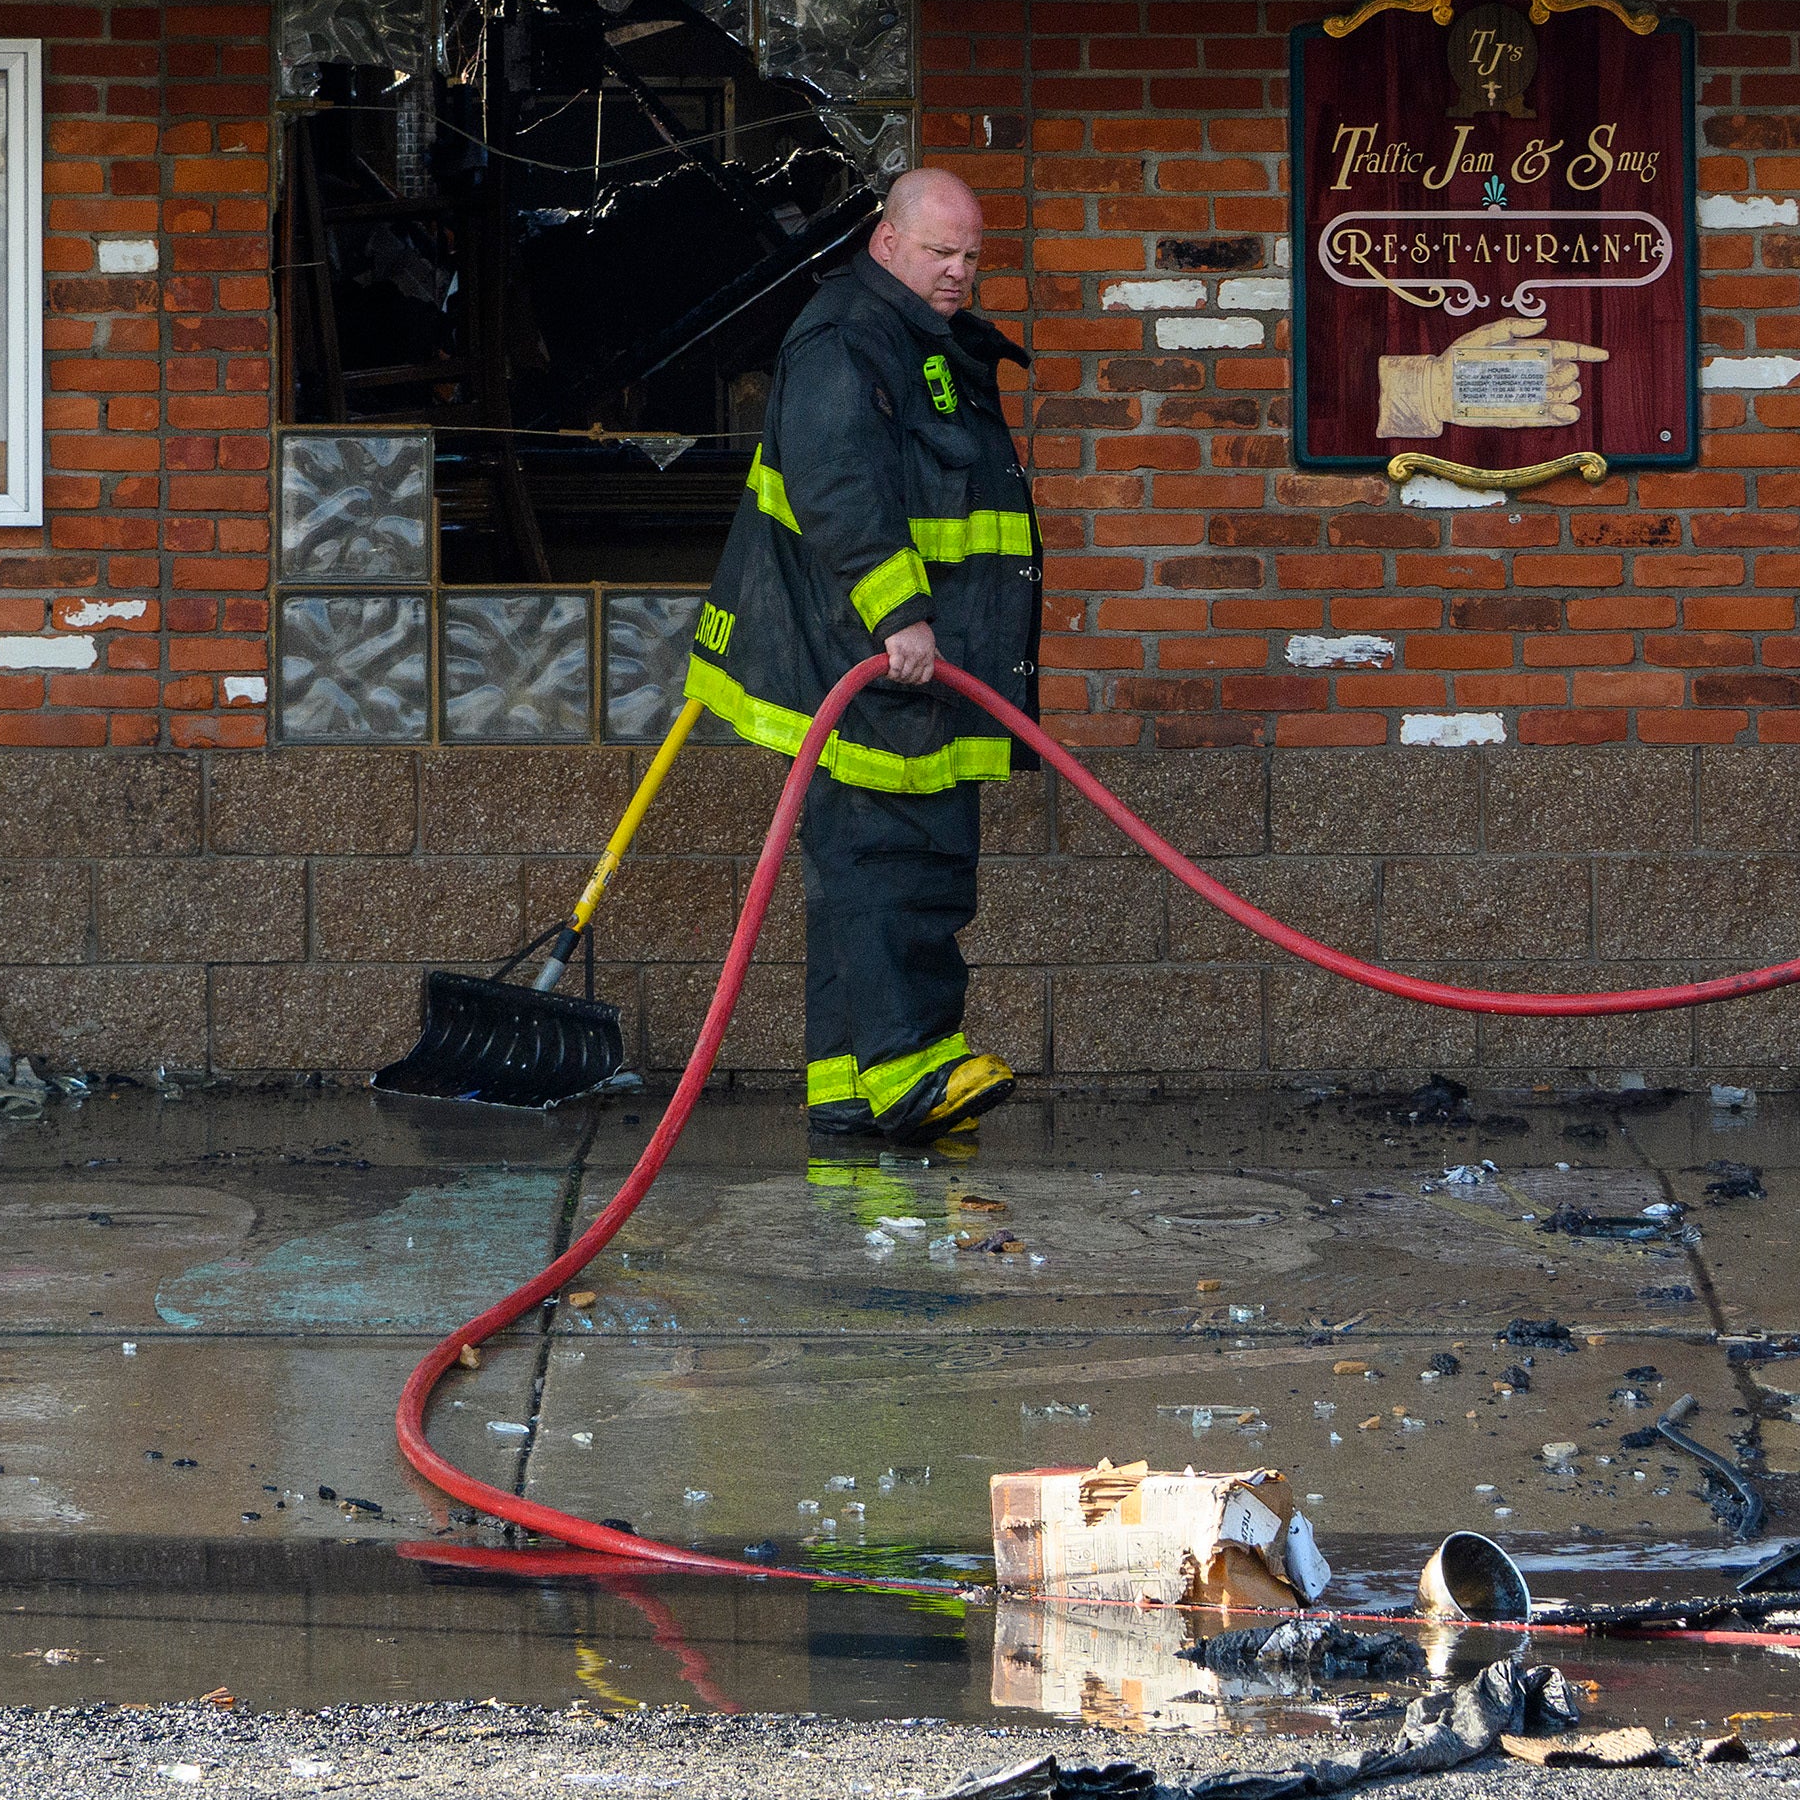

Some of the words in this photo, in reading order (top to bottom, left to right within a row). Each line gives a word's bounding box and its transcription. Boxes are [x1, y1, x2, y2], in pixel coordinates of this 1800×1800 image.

[1468, 28, 1524, 76] TJ's
[1330, 122, 1424, 191] Traffic
[1422, 125, 1495, 190] Jam
[1511, 139, 1565, 184] &
[1566, 122, 1661, 191] Snug
